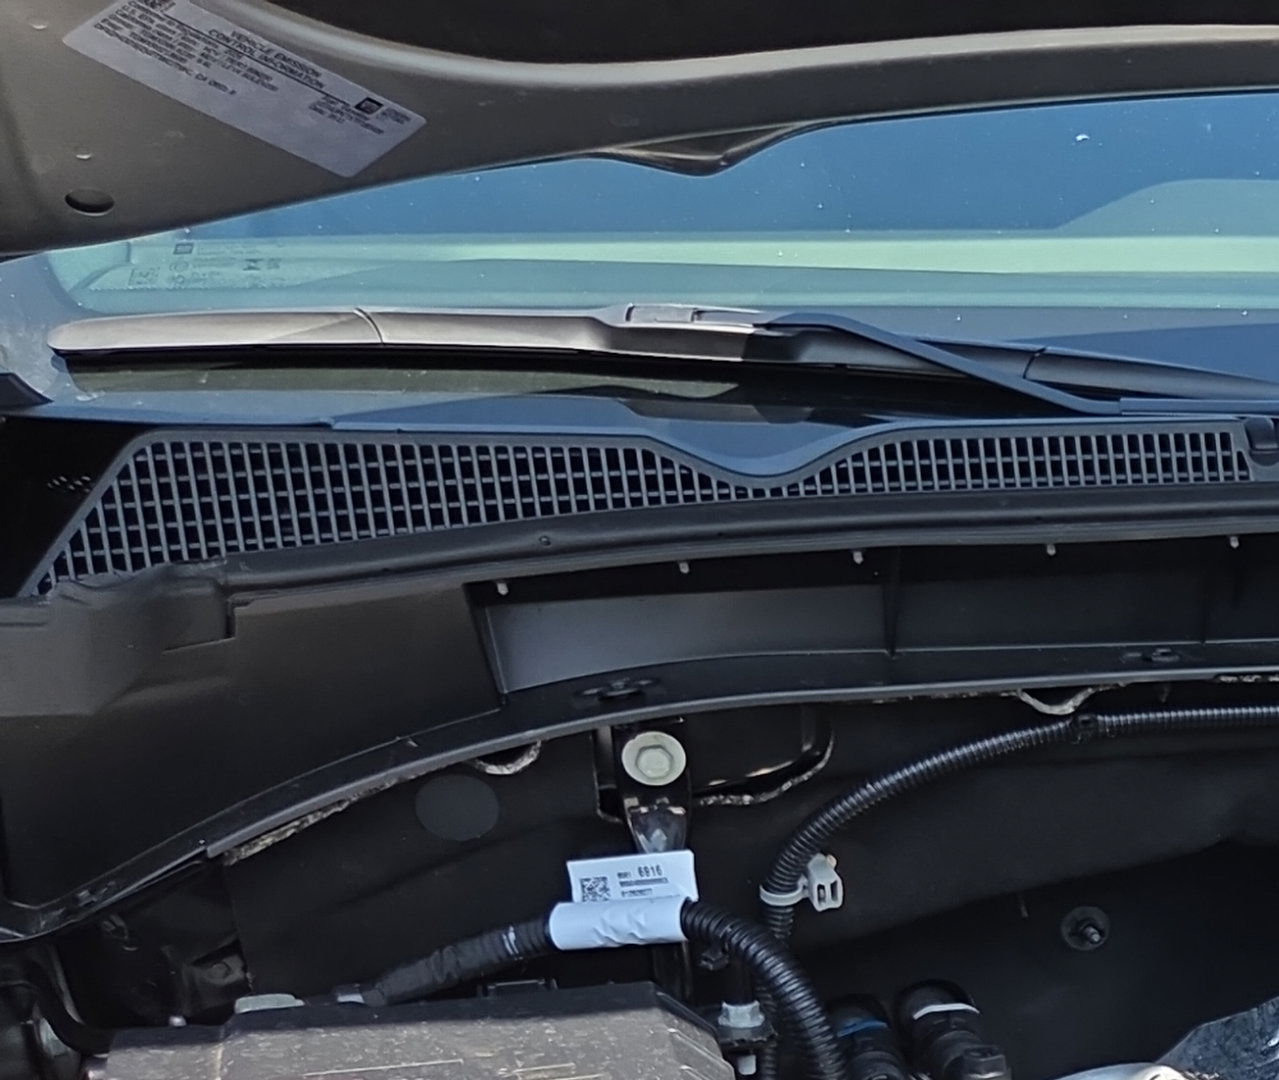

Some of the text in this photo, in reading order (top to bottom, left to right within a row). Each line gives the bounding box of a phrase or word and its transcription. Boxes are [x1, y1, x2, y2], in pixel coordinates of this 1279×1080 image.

[208, 29, 256, 56] CONTROL
[258, 54, 325, 88] INFORMATION
[231, 30, 275, 54] VEHICLE
[274, 52, 322, 77] EMISSION
